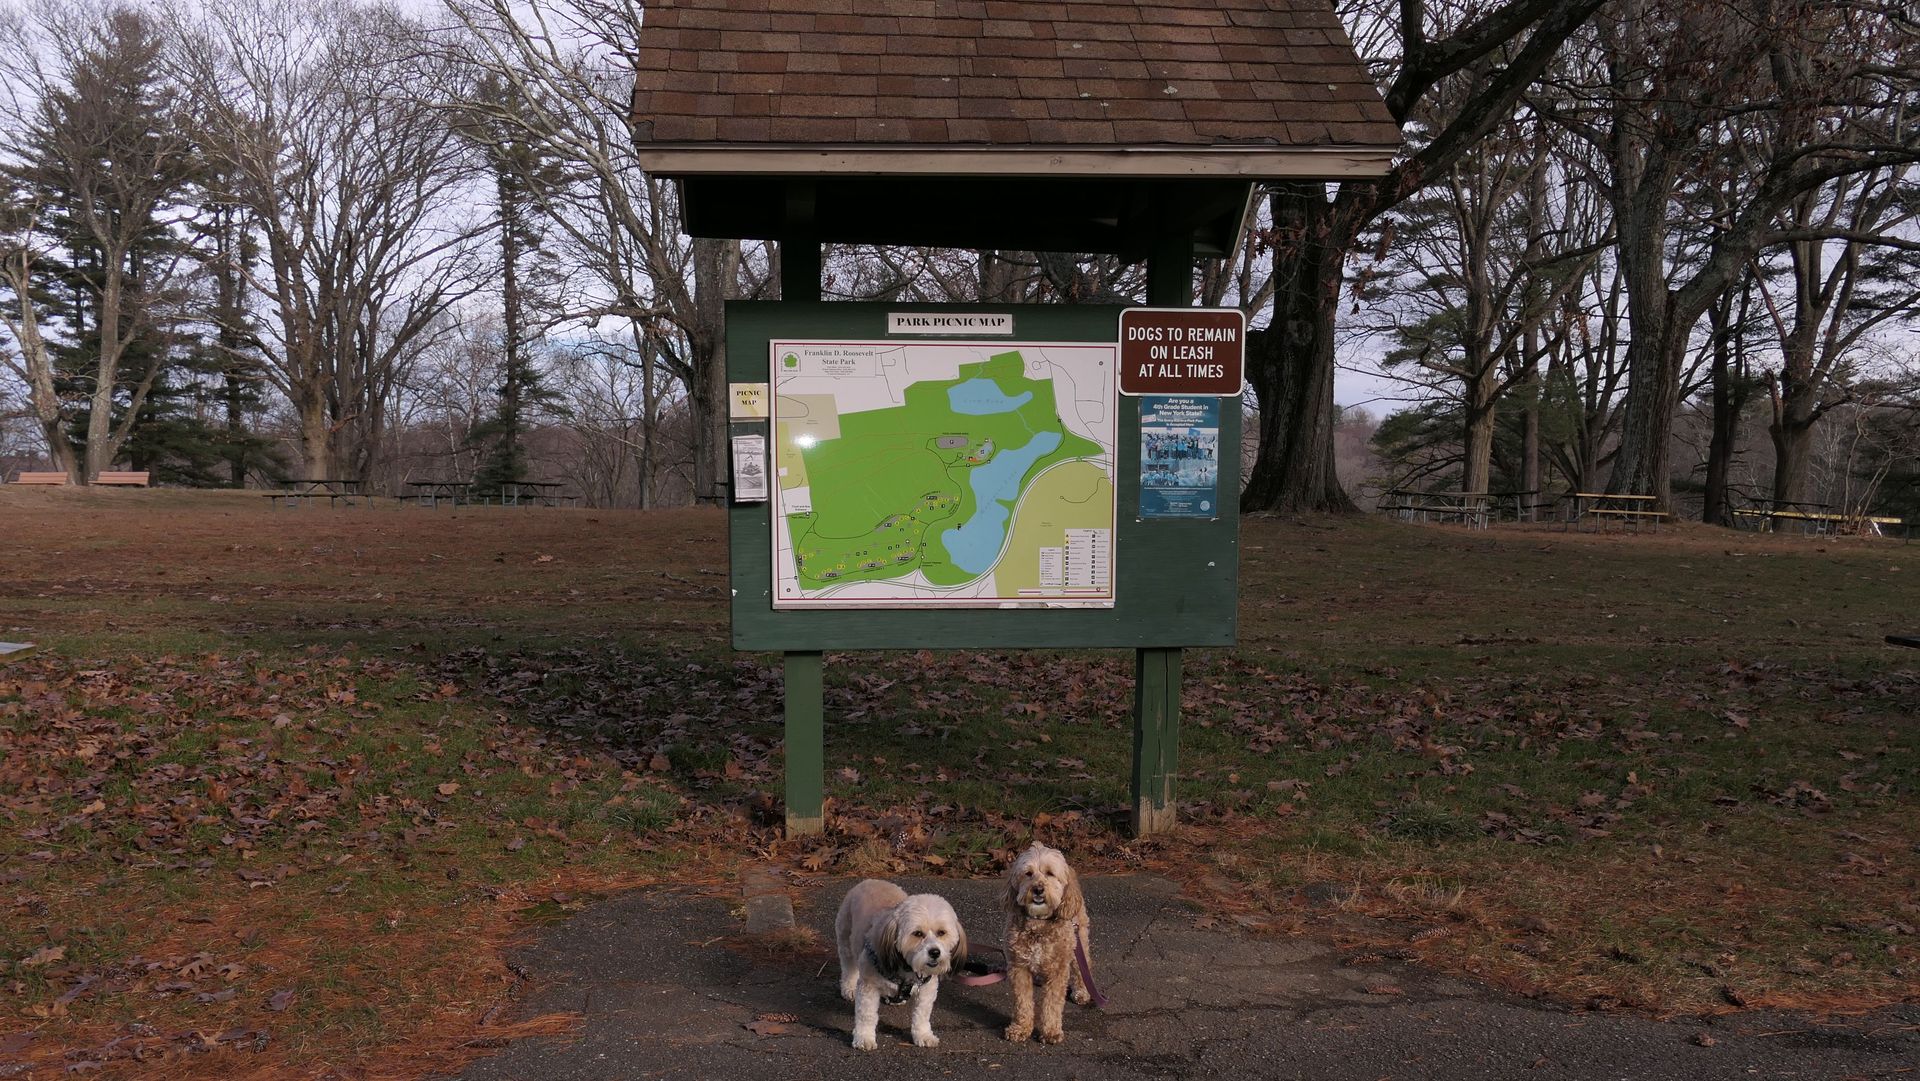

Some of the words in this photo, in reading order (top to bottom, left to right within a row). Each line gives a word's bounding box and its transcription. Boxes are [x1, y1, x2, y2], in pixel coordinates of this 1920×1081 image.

[897, 317, 930, 327] PARK
[933, 317, 977, 327] PICNIC
[979, 317, 1005, 327] MAP
[1128, 327, 1163, 341] DOGS
[1167, 327, 1183, 341] TO
[1187, 327, 1236, 342] REMAIN
[1150, 346, 1168, 360] ON
[1173, 346, 1214, 360] LEASH
[1138, 364, 1155, 378] AT
[1158, 364, 1183, 378] ALL
[1186, 364, 1224, 378] TIMES
